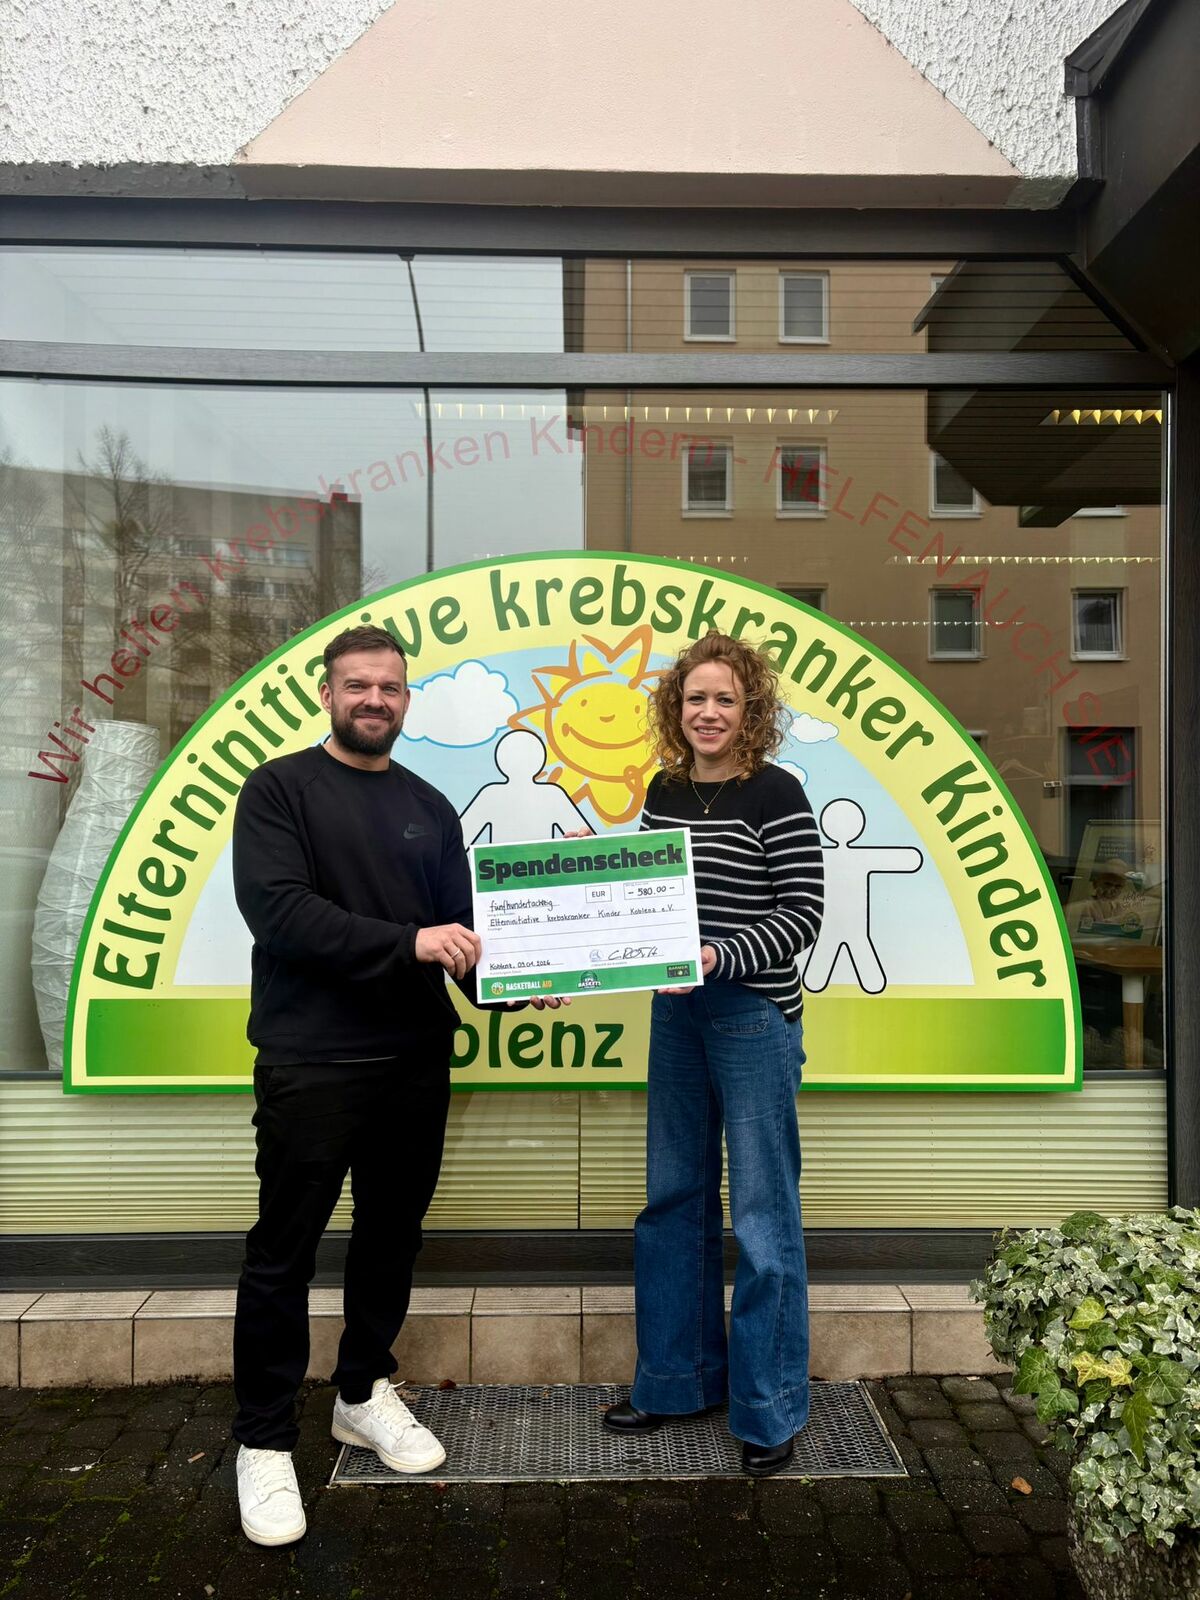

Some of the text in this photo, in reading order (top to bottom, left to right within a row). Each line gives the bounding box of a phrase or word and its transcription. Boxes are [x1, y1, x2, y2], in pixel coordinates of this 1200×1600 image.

[28, 706, 96, 784] Wir
[80, 578, 206, 705] helfen
[199, 430, 511, 582] krebskranken
[529, 414, 717, 467] Kindern
[762, 446, 961, 578] HELFEN
[951, 569, 1079, 696] AUCH
[489, 564, 935, 761] krebskranker
[920, 759, 1048, 989] Kinder
[478, 843, 684, 885] Spendenscheck
[591, 890, 606, 898] EUR
[598, 909, 621, 918] Kinder
[505, 981, 541, 991] BASKETBALL
